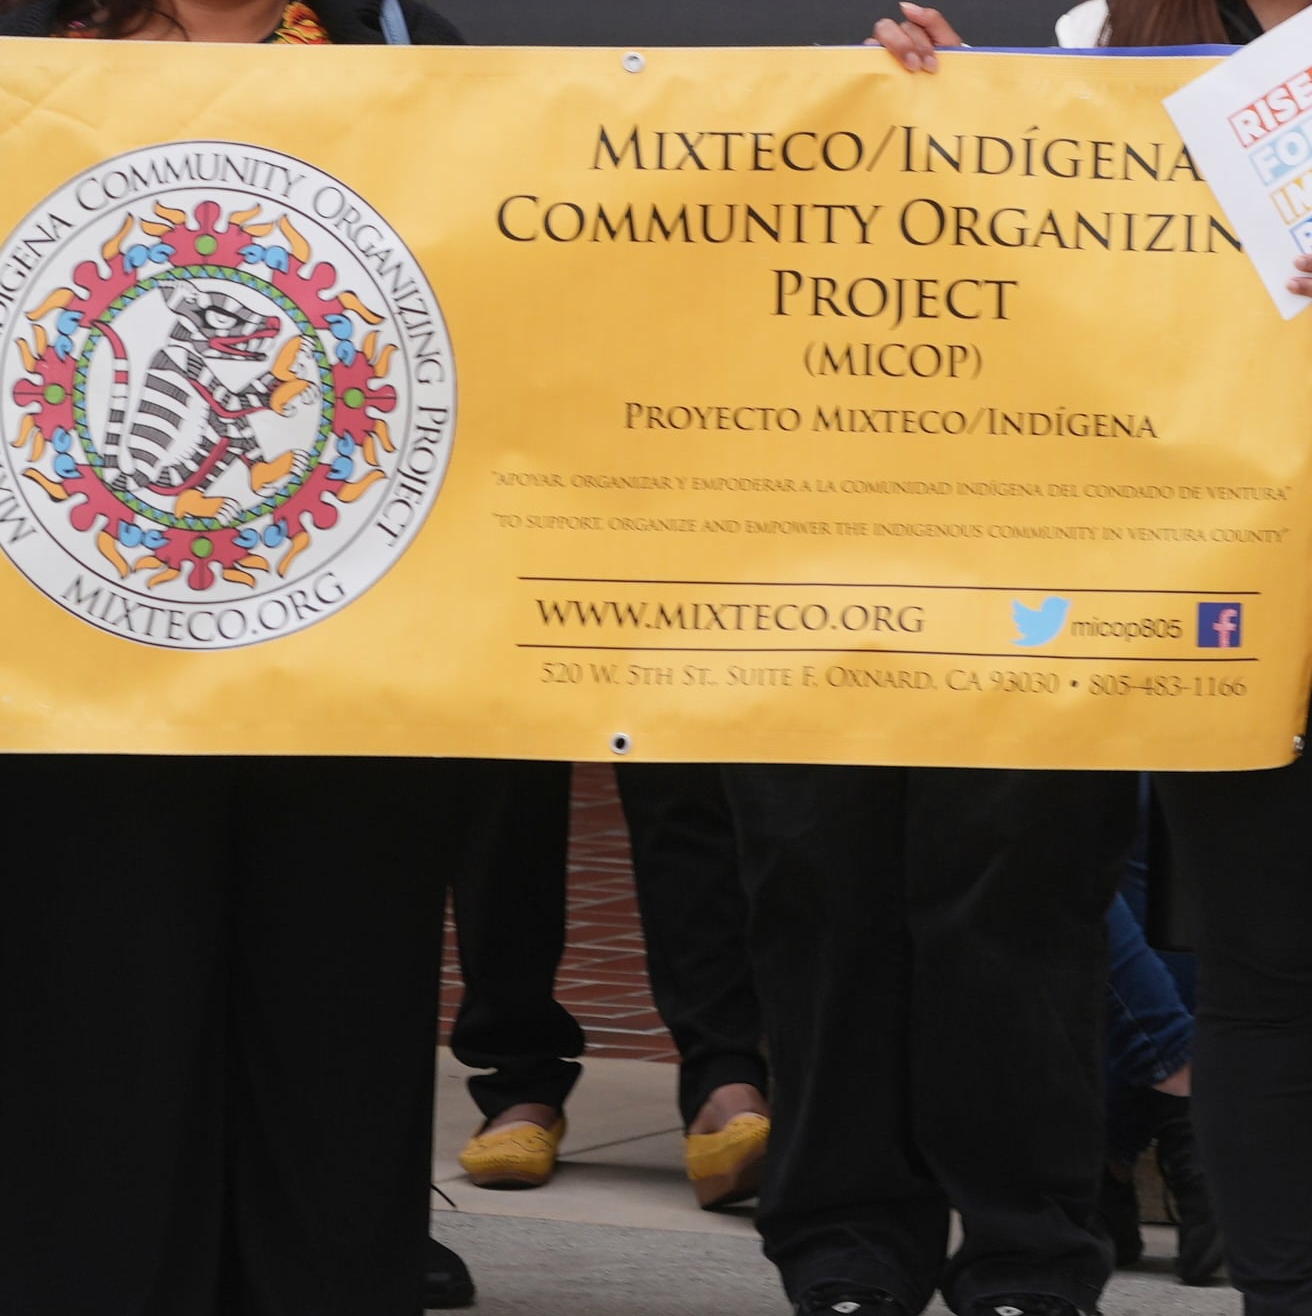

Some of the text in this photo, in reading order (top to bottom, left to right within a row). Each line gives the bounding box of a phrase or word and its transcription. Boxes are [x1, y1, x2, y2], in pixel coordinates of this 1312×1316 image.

[74, 152, 309, 213] COMMUNITY
[589, 124, 1206, 182] MIXTECO/INDÍGENA
[497, 194, 1245, 254] COMMUNITY ORGANIZIN
[313, 185, 449, 388] ORGANIZING
[769, 269, 1019, 331] PROJECT
[803, 341, 983, 380] (MICOP)
[623, 400, 1160, 440] PROYECTO MIXTECO/INDÍGENA
[374, 404, 450, 548] PROJECT
[60, 570, 350, 643] MIXTECO.ORG
[534, 599, 927, 634] WWW.MIXTECO.ORG
[1071, 616, 1184, 643] micop805
[540, 662, 583, 685] 520
[944, 668, 984, 693] CA
[989, 670, 1060, 695] 93030
[1088, 672, 1248, 698] 805-483-1166
